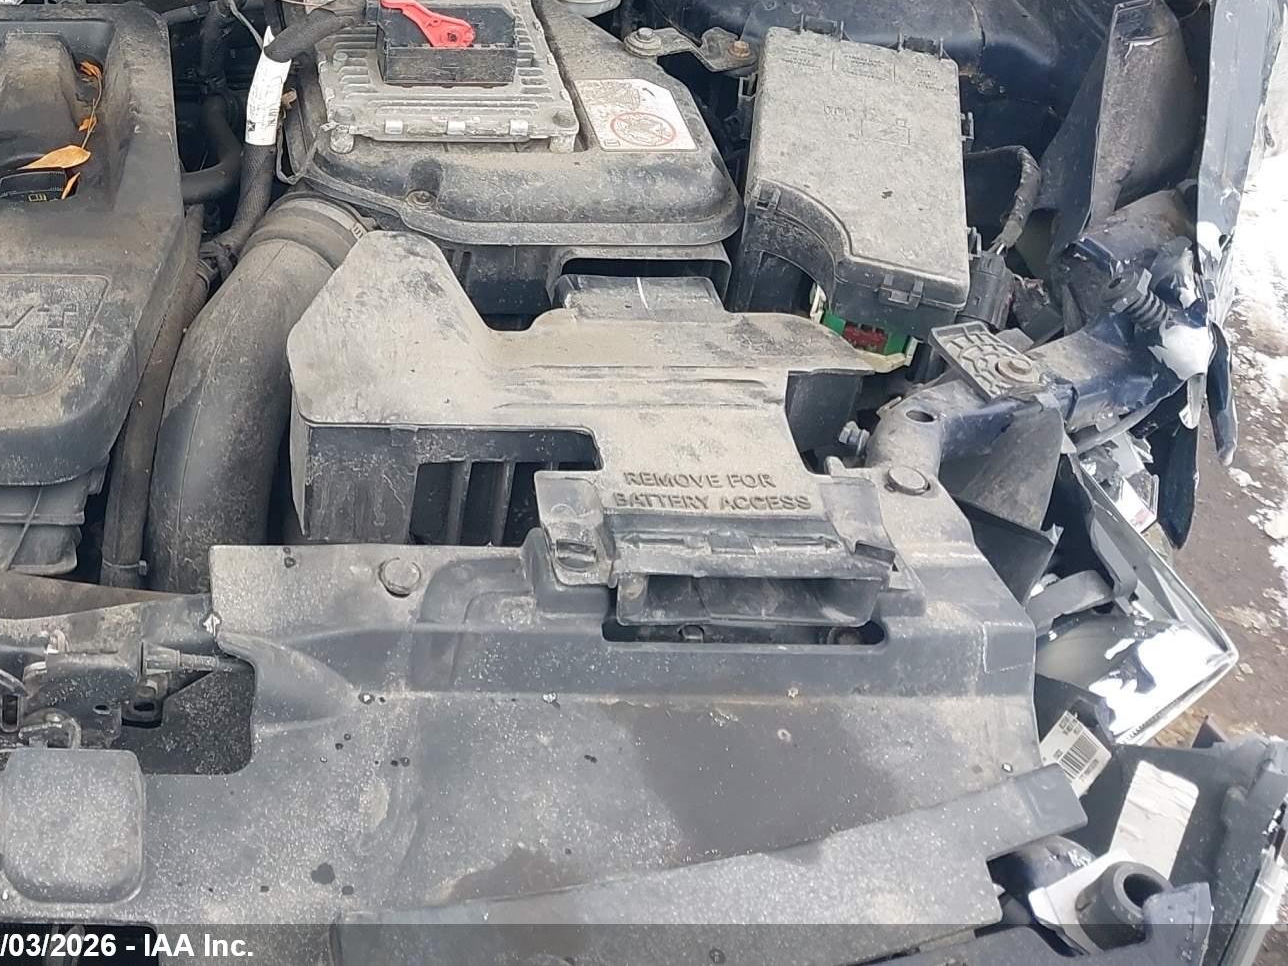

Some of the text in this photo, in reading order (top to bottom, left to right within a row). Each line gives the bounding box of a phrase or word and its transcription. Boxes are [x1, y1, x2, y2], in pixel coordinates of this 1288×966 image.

[623, 471, 777, 489] REMOVE FOR
[612, 491, 813, 512] BATTERY ACCESS
